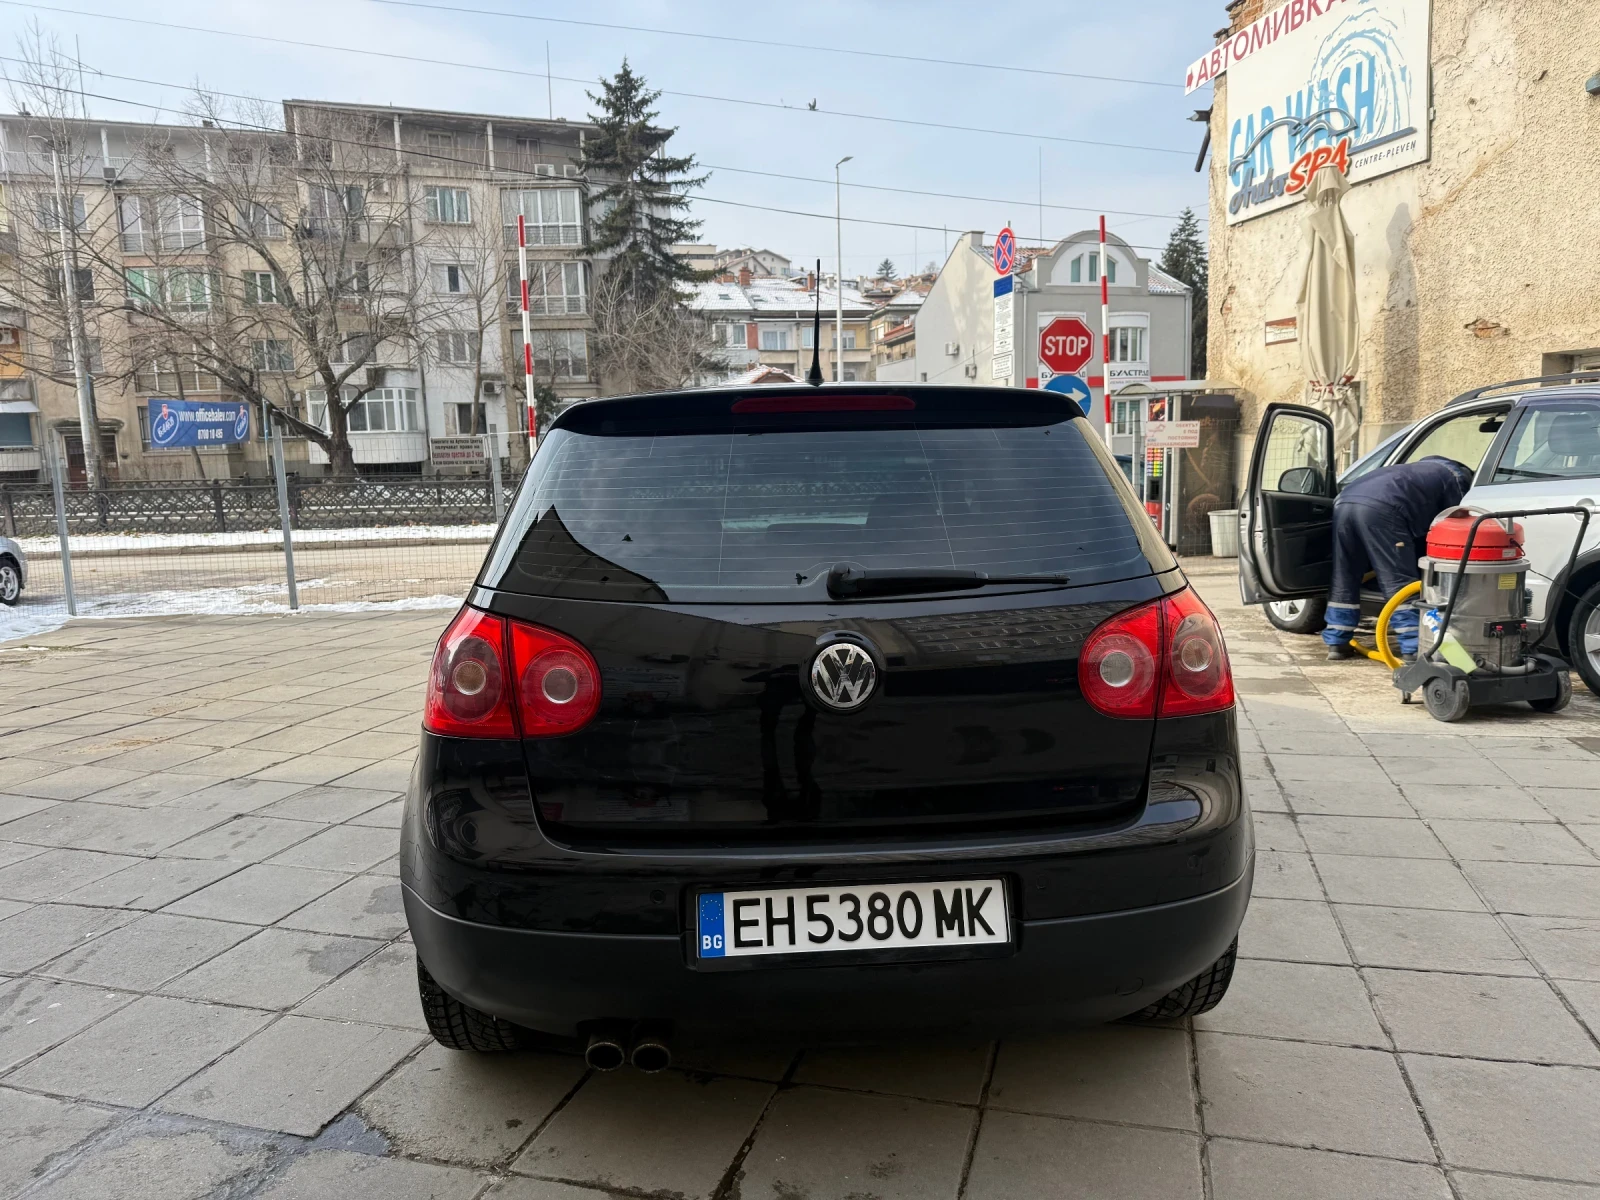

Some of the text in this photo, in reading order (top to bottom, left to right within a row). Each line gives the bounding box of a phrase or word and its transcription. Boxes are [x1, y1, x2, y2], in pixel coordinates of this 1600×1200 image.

[1230, 55, 1376, 187] CAR WASH
[1229, 137, 1349, 214] Auto SPA
[1355, 140, 1417, 168] CENTRE-PLEVEN
[1045, 335, 1089, 356] STOP
[732, 887, 996, 948] EH 5380 MK
[702, 935, 723, 950] BG
